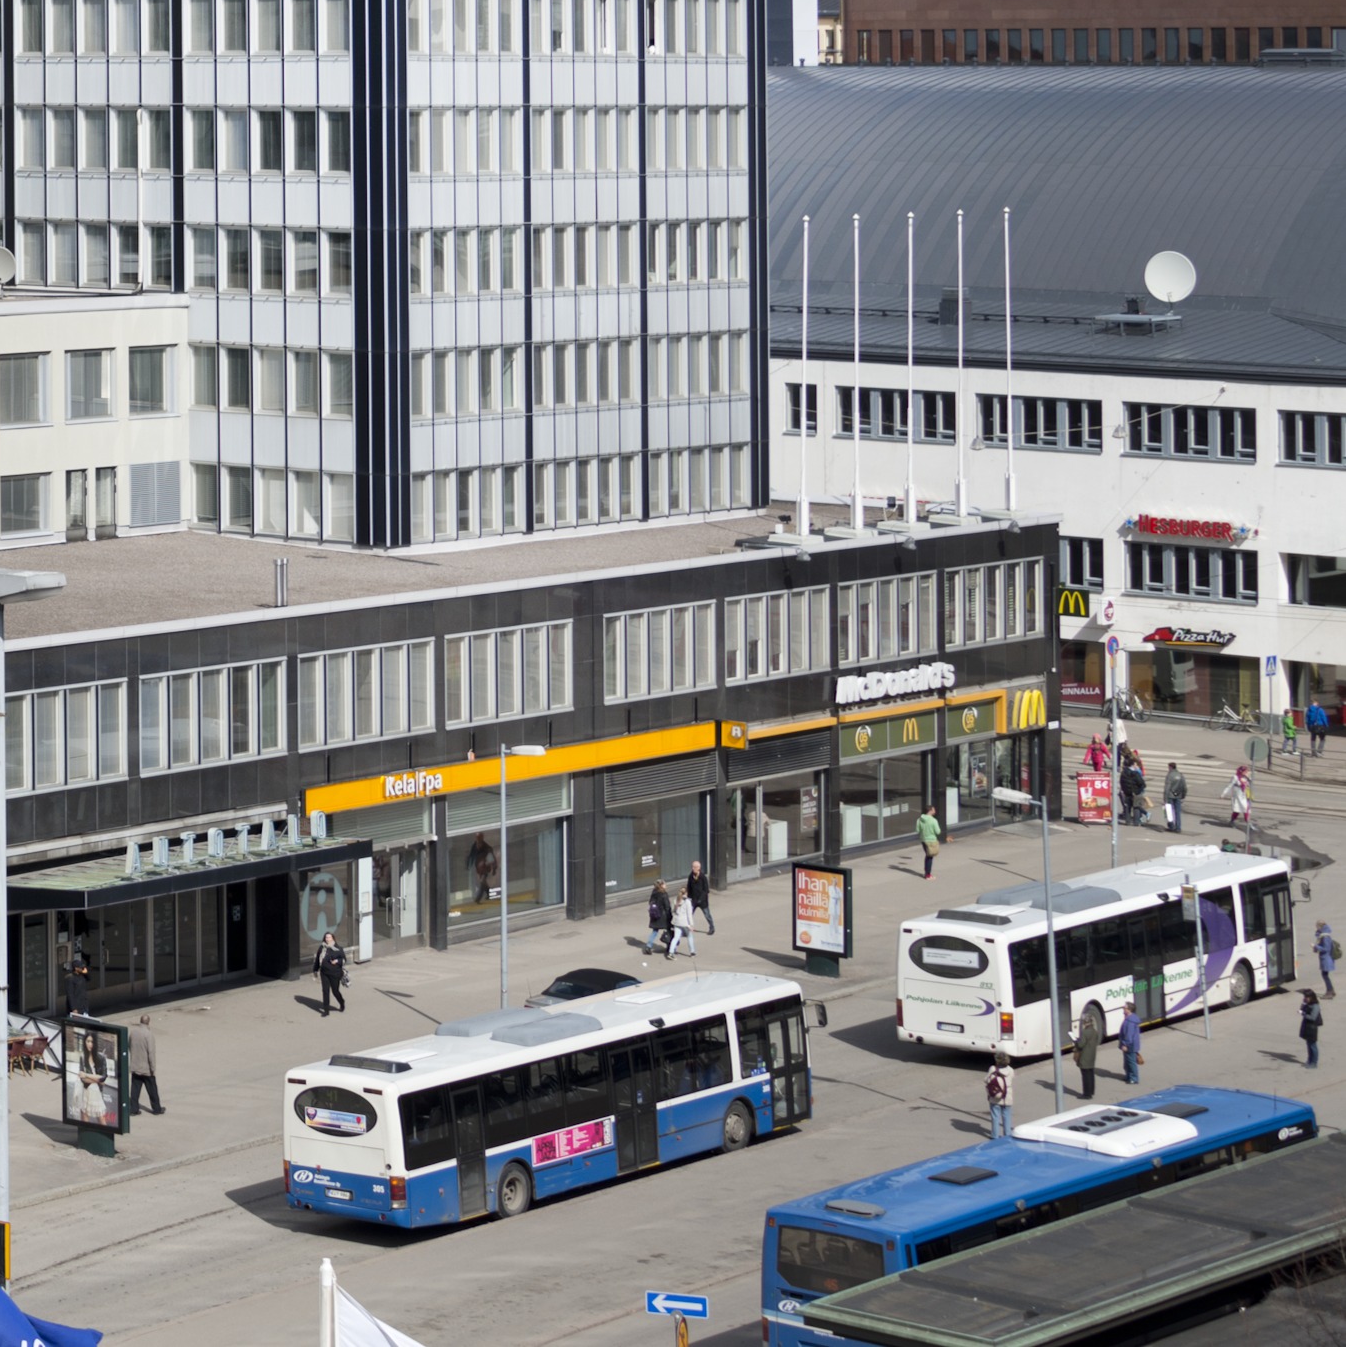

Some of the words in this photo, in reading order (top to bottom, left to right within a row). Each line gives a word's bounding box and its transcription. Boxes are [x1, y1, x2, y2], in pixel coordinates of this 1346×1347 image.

[1138, 514, 1234, 542] HESBURGER
[835, 662, 956, 704] McDonald's
[799, 872, 828, 892] Ihan
[798, 892, 829, 908] näillä
[1105, 979, 1148, 1000] Pohjolan
[1150, 968, 1194, 988] Liikenne
[906, 994, 943, 1005] Pohjolan
[945, 999, 983, 1010] Liikenne
